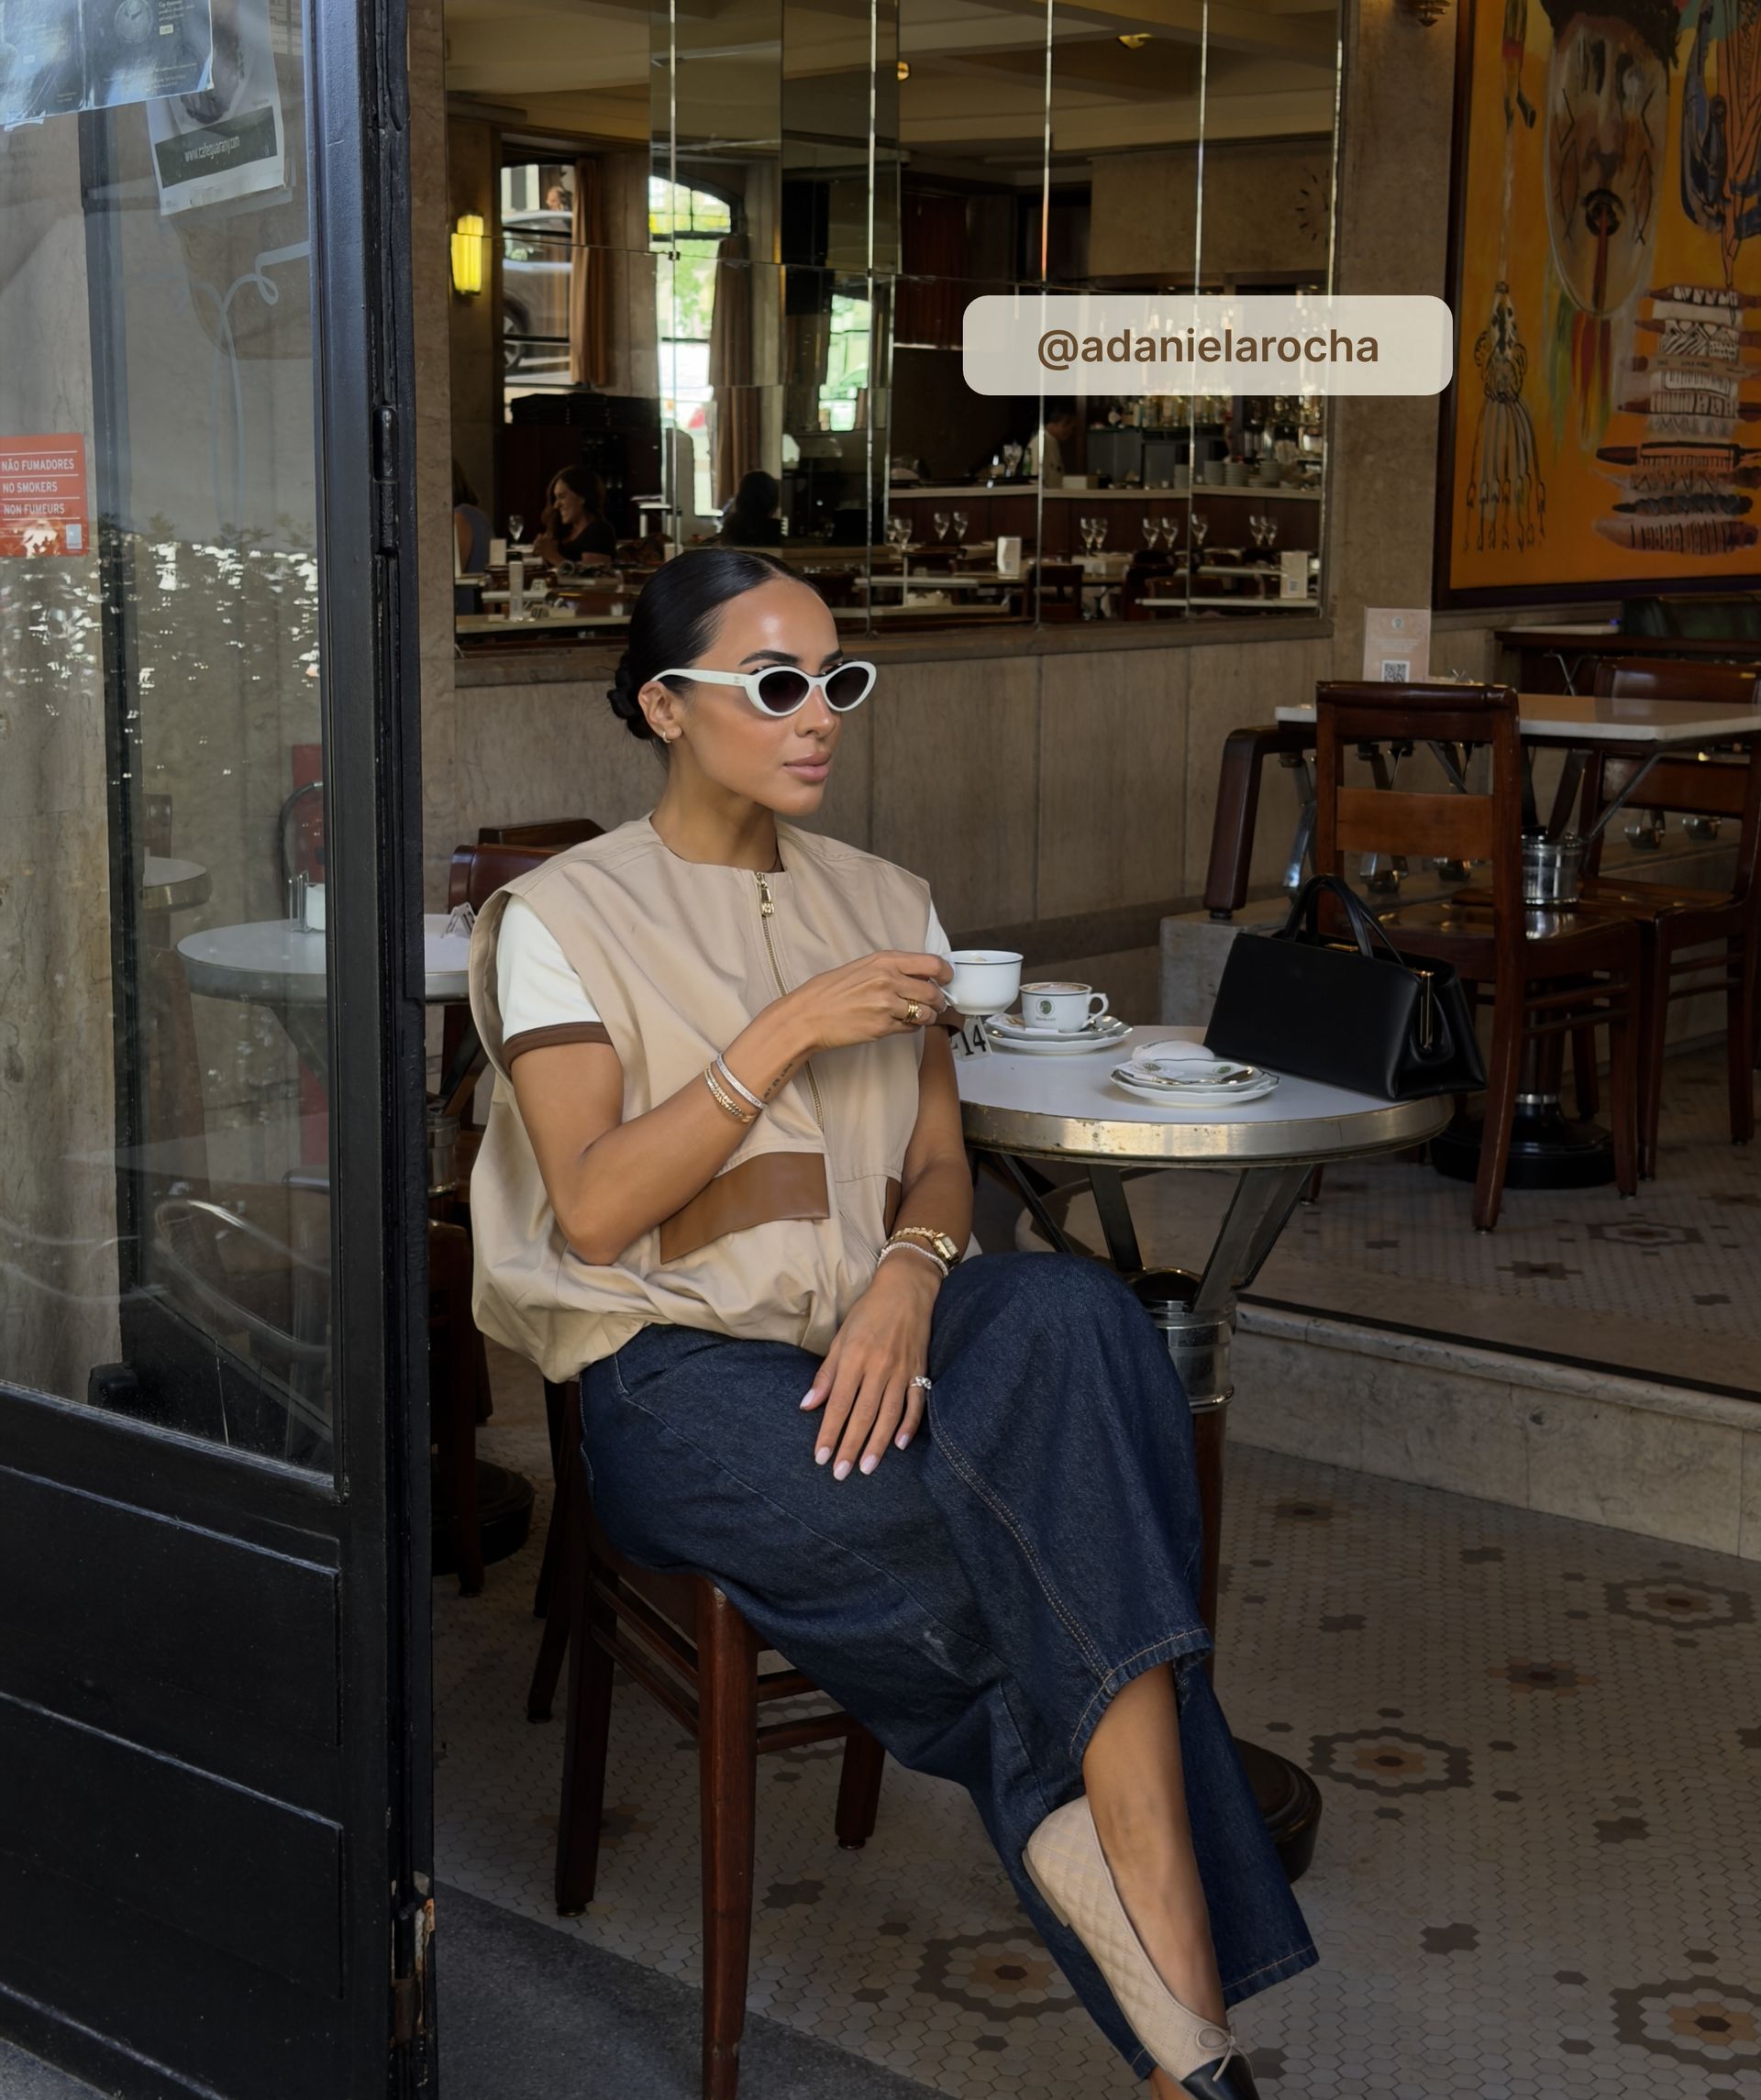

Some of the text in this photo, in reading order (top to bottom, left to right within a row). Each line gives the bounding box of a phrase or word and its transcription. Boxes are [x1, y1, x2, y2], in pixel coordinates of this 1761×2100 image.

[1, 458, 74, 471] NÃO FUMADORES
[3, 481, 58, 493] NO SMOKERS
[4, 503, 65, 514] NON FUMEURS
[960, 1024, 987, 1056] 14
